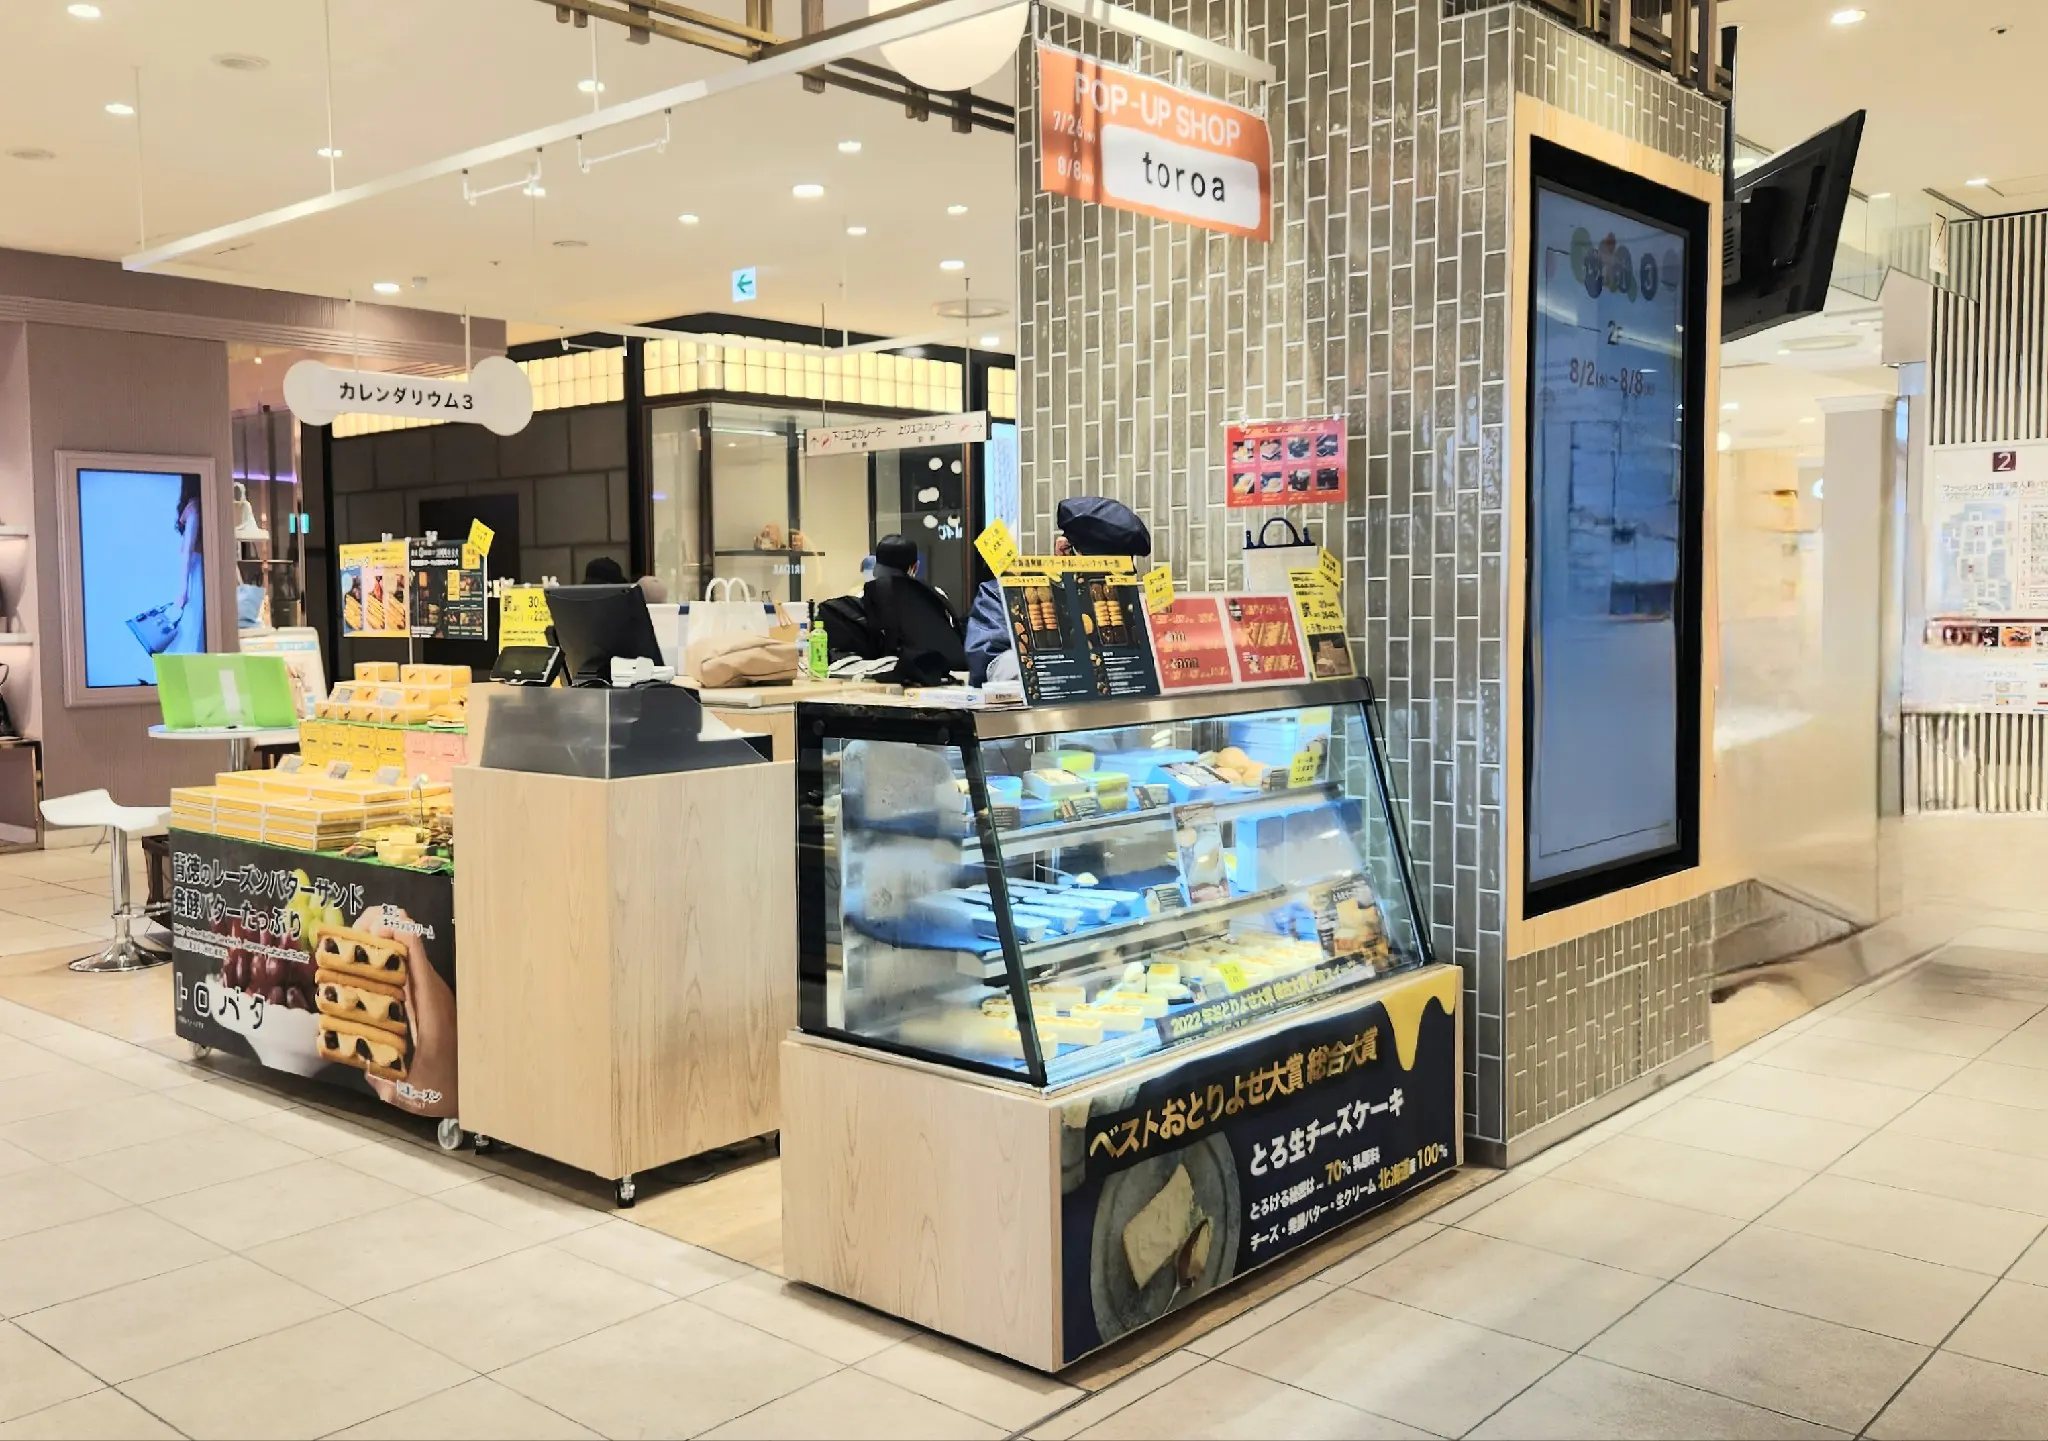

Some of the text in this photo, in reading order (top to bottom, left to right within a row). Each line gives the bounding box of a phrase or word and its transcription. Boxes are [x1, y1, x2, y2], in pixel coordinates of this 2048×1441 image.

[1075, 72, 1241, 147] POP-UP SHOP
[1143, 152, 1226, 202] toroa
[339, 382, 474, 410] カレンダリウム3
[1997, 452, 2011, 471] 2
[173, 851, 365, 915] 背徳のレーズンバターサンド
[173, 887, 301, 940] 発酵バターたっぷり
[177, 972, 266, 1029] トロバタ
[1089, 1025, 1380, 1159] ベストおとりよせ大賞 総合大賞
[1250, 1088, 1405, 1177] とろ生チーズケーキ
[1417, 1143, 1449, 1170] 100%
[1324, 1158, 1352, 1186] 70%
